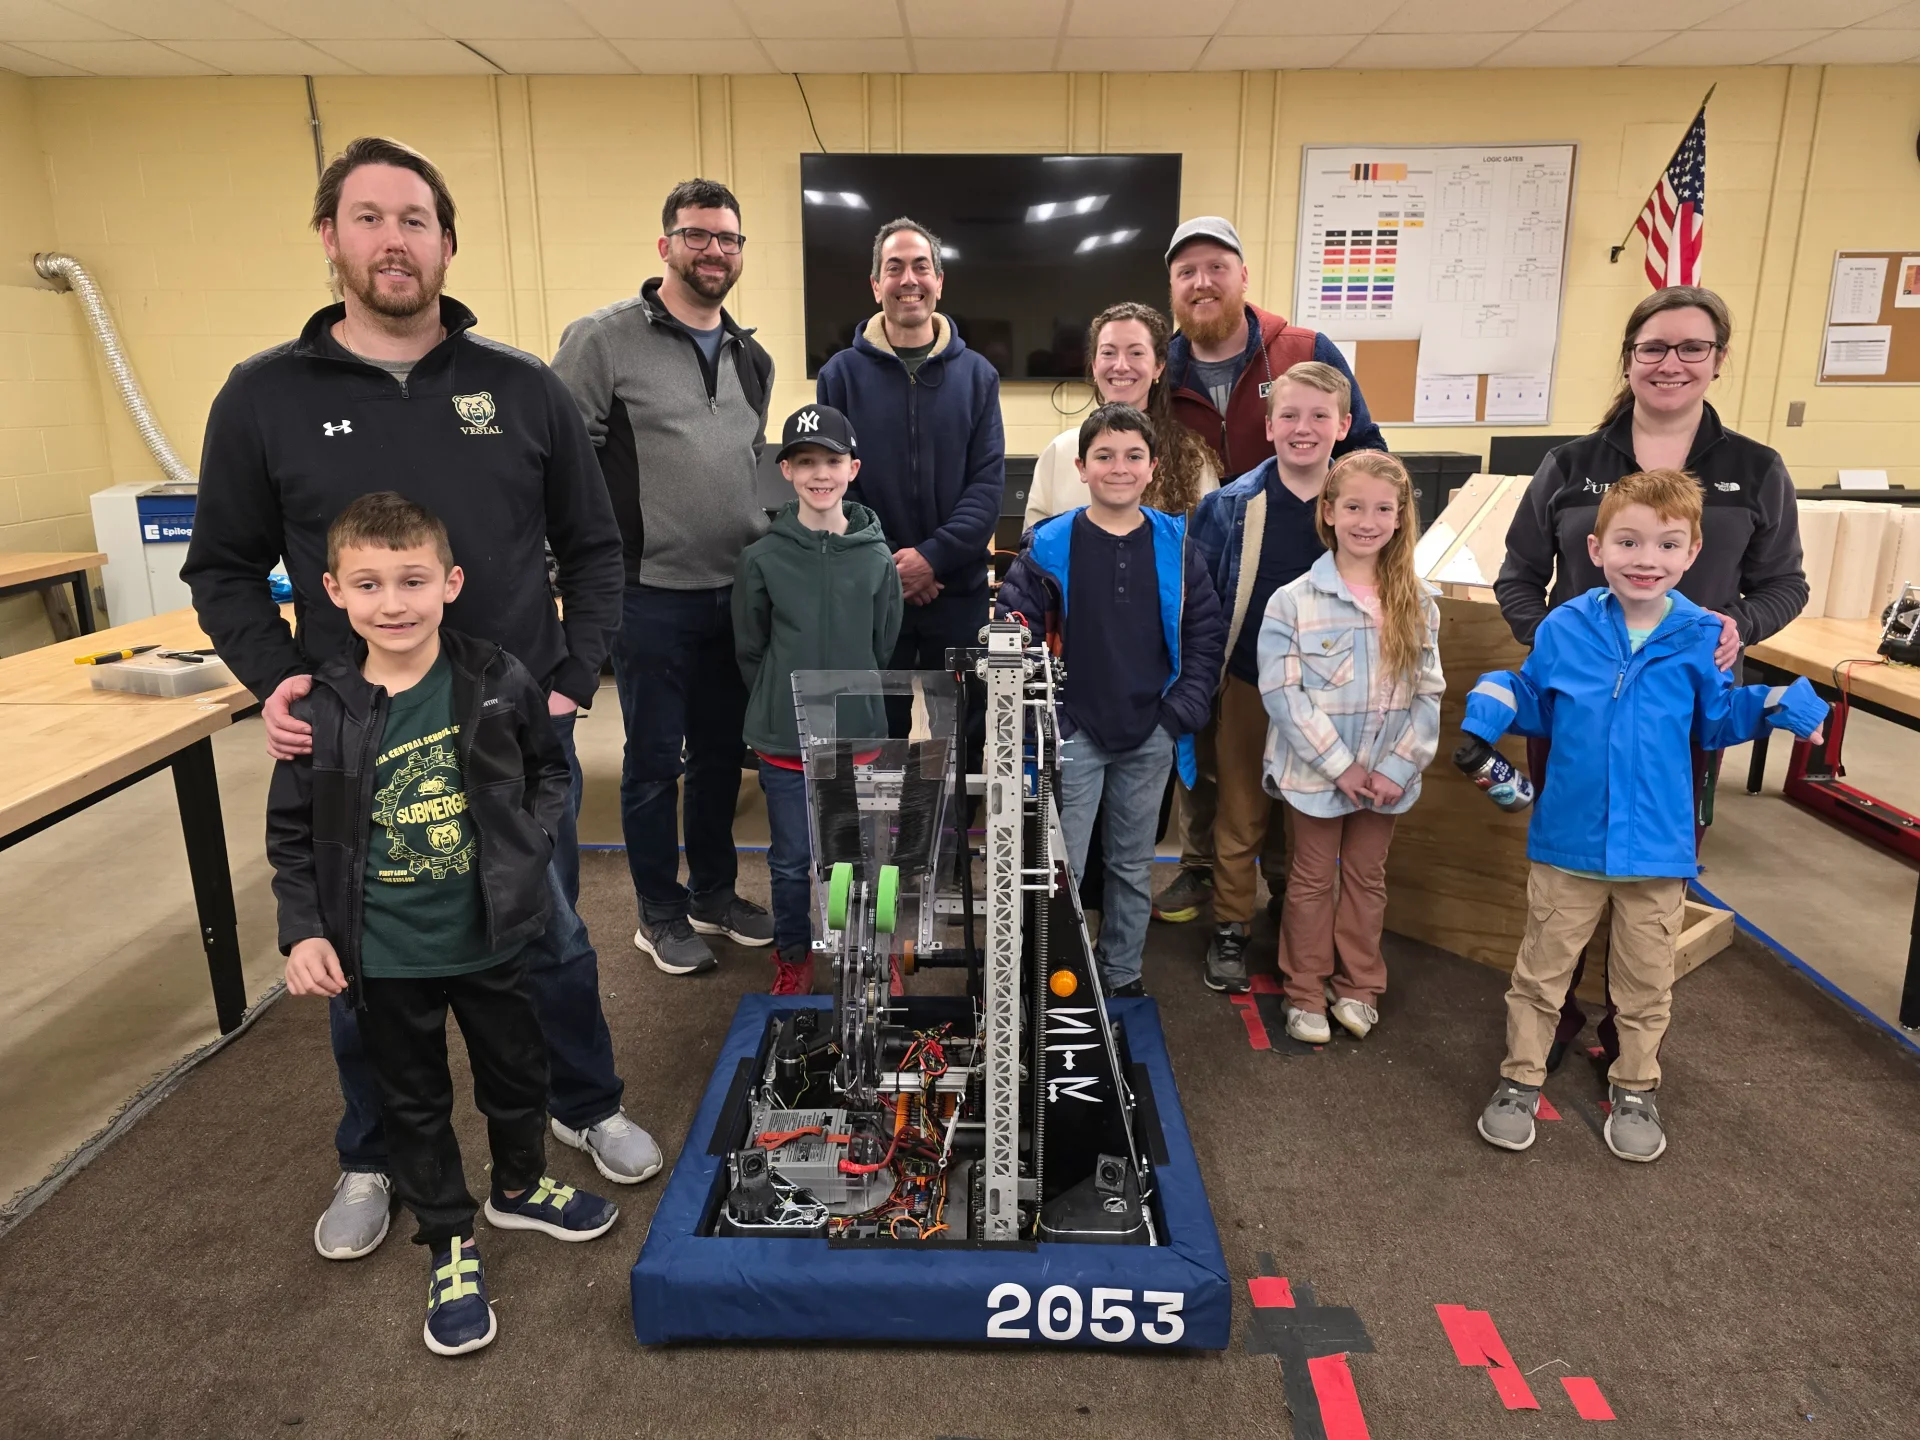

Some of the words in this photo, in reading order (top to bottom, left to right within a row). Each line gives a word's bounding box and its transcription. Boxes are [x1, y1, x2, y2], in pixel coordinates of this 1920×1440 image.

[460, 426, 503, 435] VESTAL
[796, 410, 820, 433] NY
[162, 527, 193, 537] Epilog
[388, 738, 424, 759] CENTRAL
[423, 727, 452, 745] SCHOOL
[986, 1281, 1186, 1345] 2053
